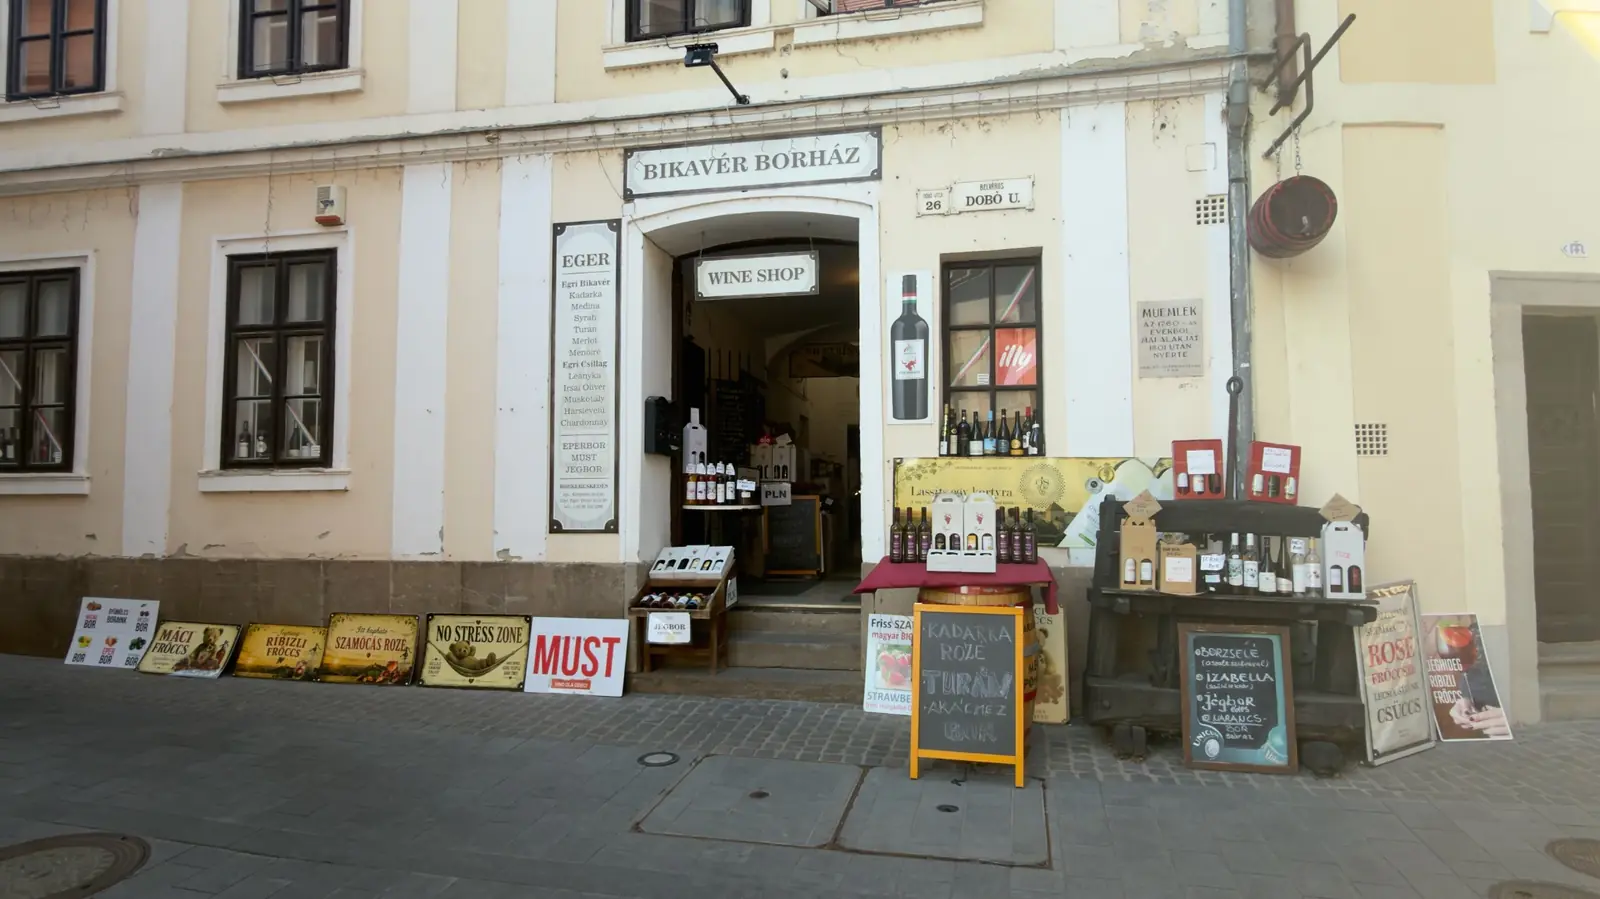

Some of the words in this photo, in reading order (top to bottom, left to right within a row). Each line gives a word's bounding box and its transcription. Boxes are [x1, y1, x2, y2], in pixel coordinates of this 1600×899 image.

[643, 152, 748, 180] BIKAVÉR
[754, 144, 860, 171] BORHÁZ
[1008, 193, 1020, 204] U.
[926, 200, 942, 210] 26
[562, 253, 610, 268] EGER
[708, 270, 752, 284] WINE
[756, 268, 805, 282] SHOP
[569, 291, 602, 300] Kadarka
[571, 302, 600, 310] Medina
[574, 314, 597, 323] Syrah
[998, 344, 1032, 372] illy
[580, 360, 608, 368] Csillag
[765, 490, 787, 498] PLN
[83, 620, 96, 628] BOR
[135, 623, 149, 632] BOR
[871, 619, 892, 628] Friss
[895, 620, 913, 629] SZA
[436, 625, 452, 642] NO
[454, 625, 494, 643] STRESS
[497, 627, 523, 643] ZONE
[872, 632, 899, 640] magyar
[926, 624, 1012, 643] KADARKA
[72, 653, 86, 663] BOR
[99, 655, 112, 664] BOR
[125, 656, 138, 666] BOR
[533, 635, 621, 677] MUST
[1433, 688, 1462, 704] FRÖCCS
